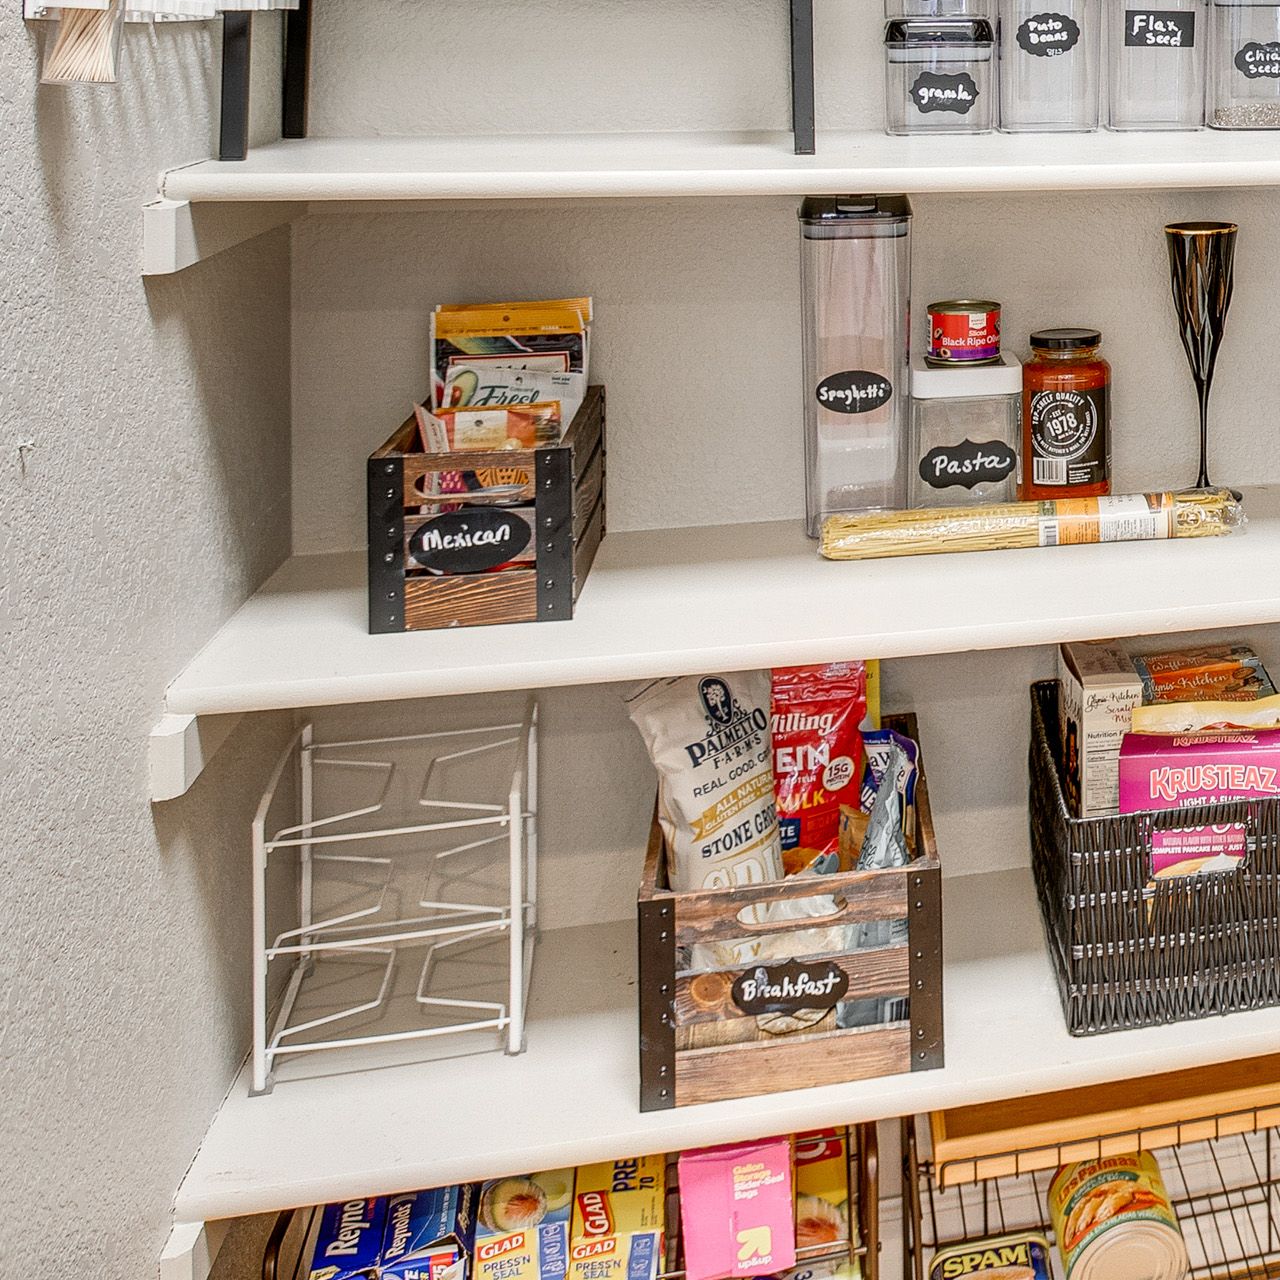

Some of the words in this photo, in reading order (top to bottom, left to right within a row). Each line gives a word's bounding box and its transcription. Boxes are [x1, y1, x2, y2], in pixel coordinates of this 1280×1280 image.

[1131, 15, 1179, 36] Flax
[1029, 31, 1069, 44] Beans
[918, 83, 973, 104] granola
[942, 337, 966, 347] Black
[967, 337, 986, 347] Ripe
[968, 329, 987, 337] Sliced
[819, 383, 886, 405] Spaghetti
[1032, 394, 1054, 425] TOP-SHELF
[1055, 392, 1085, 406] QUALITY
[1046, 412, 1078, 437] 1978
[932, 452, 1011, 477] Pasta
[422, 524, 511, 552] Mexican
[1177, 673, 1229, 690] Kitchen
[1110, 689, 1140, 703] Kitchen
[684, 707, 768, 769] PALMETTO
[1087, 730, 1119, 740] Nutrition
[1173, 734, 1258, 747] KRUSTEAZ
[827, 763, 850, 778] 15G
[1150, 765, 1280, 801] KRUSTEAZ
[715, 794, 736, 816] ALL
[1179, 797, 1208, 808] LIGHT
[1209, 796, 1218, 806] &
[704, 807, 738, 833] GLUTEN
[701, 821, 753, 860] STONE
[1151, 846, 1182, 855] COMPLETE
[1182, 845, 1210, 854] PANCAKE
[1210, 845, 1224, 853] MIX
[1228, 843, 1243, 852] JUST
[741, 972, 841, 1001] Breakfast
[639, 1176, 655, 1190] 70
[1056, 1179, 1077, 1205] Las
[1078, 1156, 1138, 1183] Palmas
[734, 1189, 759, 1201] Bags
[585, 1192, 610, 1233] GLAD
[325, 1199, 371, 1257] Reyno
[384, 1202, 413, 1260] Reynolds
[480, 1234, 524, 1260] GLAD
[572, 1239, 616, 1261] GLAD
[483, 1254, 531, 1273] PRESS'N
[575, 1259, 621, 1271] PRESS'N
[738, 1255, 772, 1269] up&up
[943, 1242, 1028, 1278] SPAM
[493, 1267, 523, 1280] SEAL
[583, 1267, 611, 1280] SEAL
